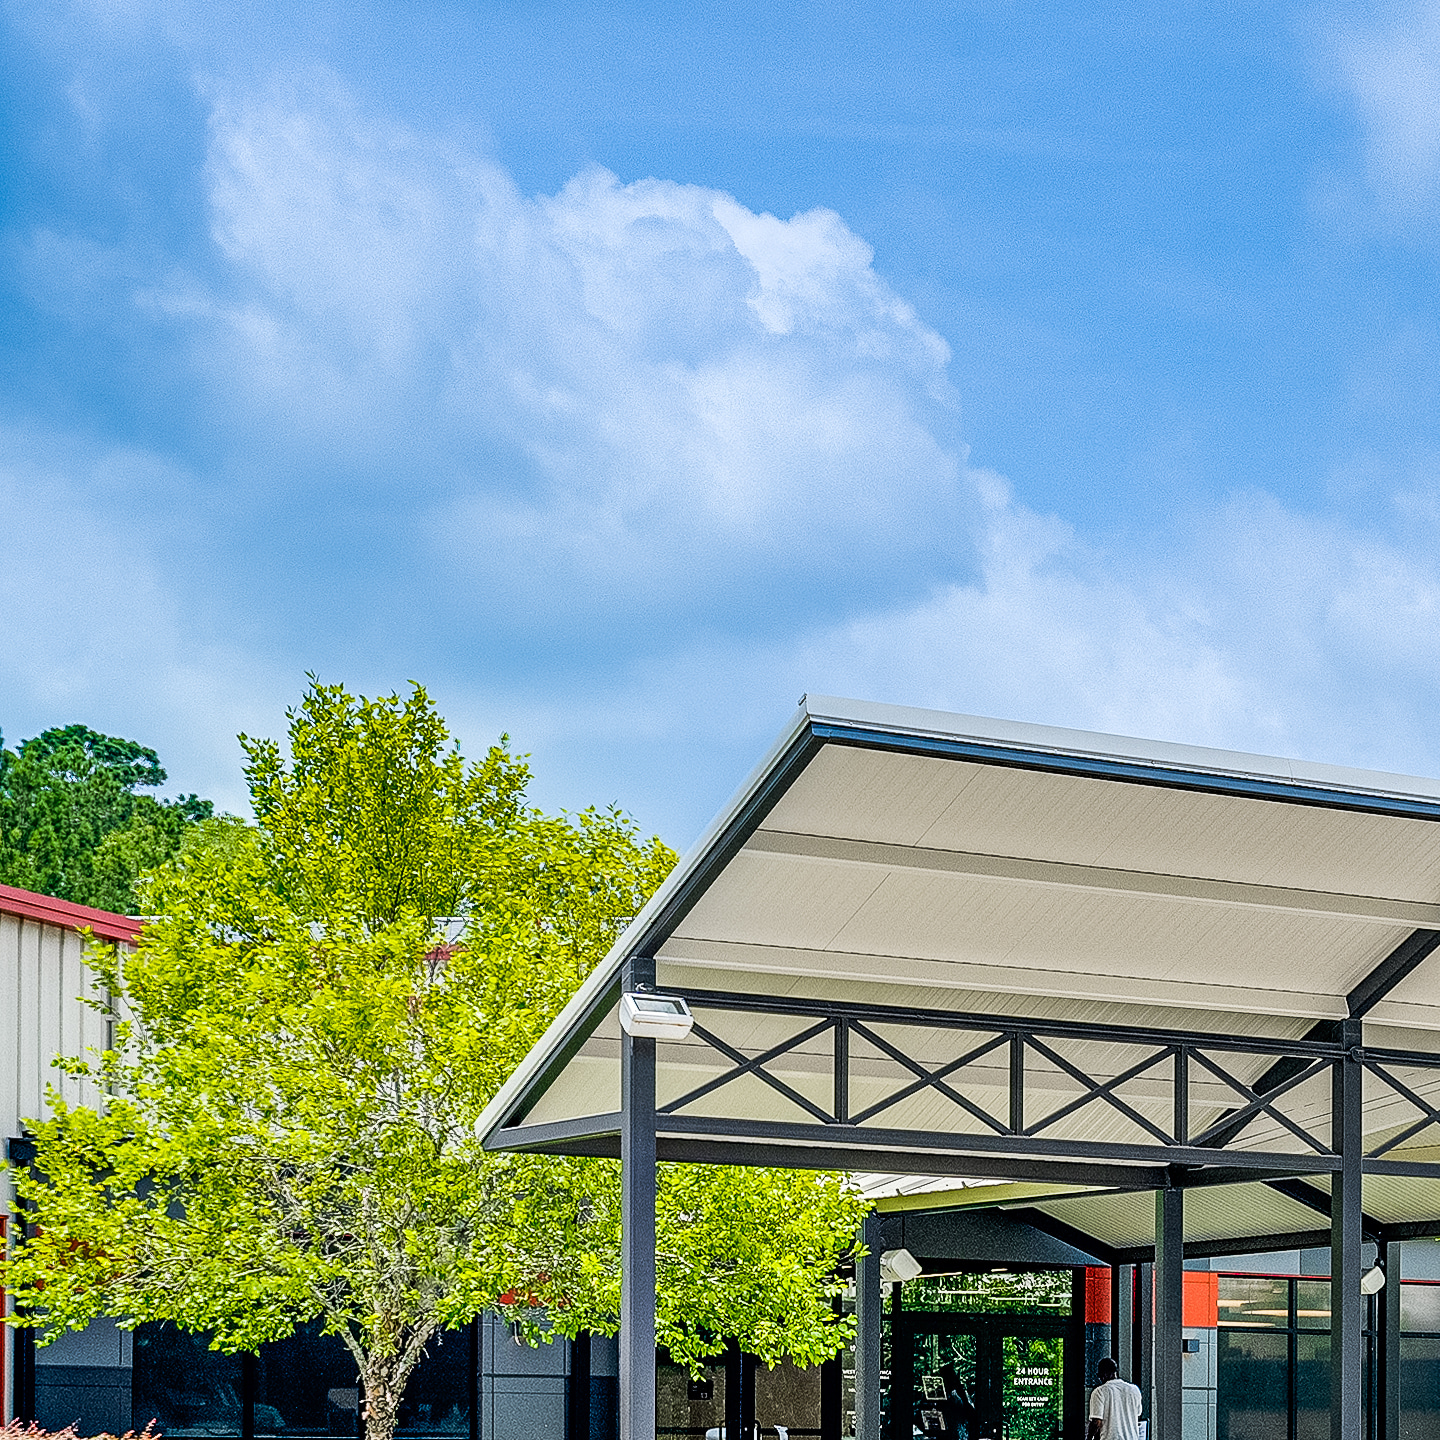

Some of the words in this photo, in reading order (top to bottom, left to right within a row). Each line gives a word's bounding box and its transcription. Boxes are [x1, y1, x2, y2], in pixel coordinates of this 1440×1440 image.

[1016, 1367, 1026, 1375] 24
[1028, 1367, 1049, 1375] HOUR
[1013, 1377, 1053, 1386] ENTRANCE
